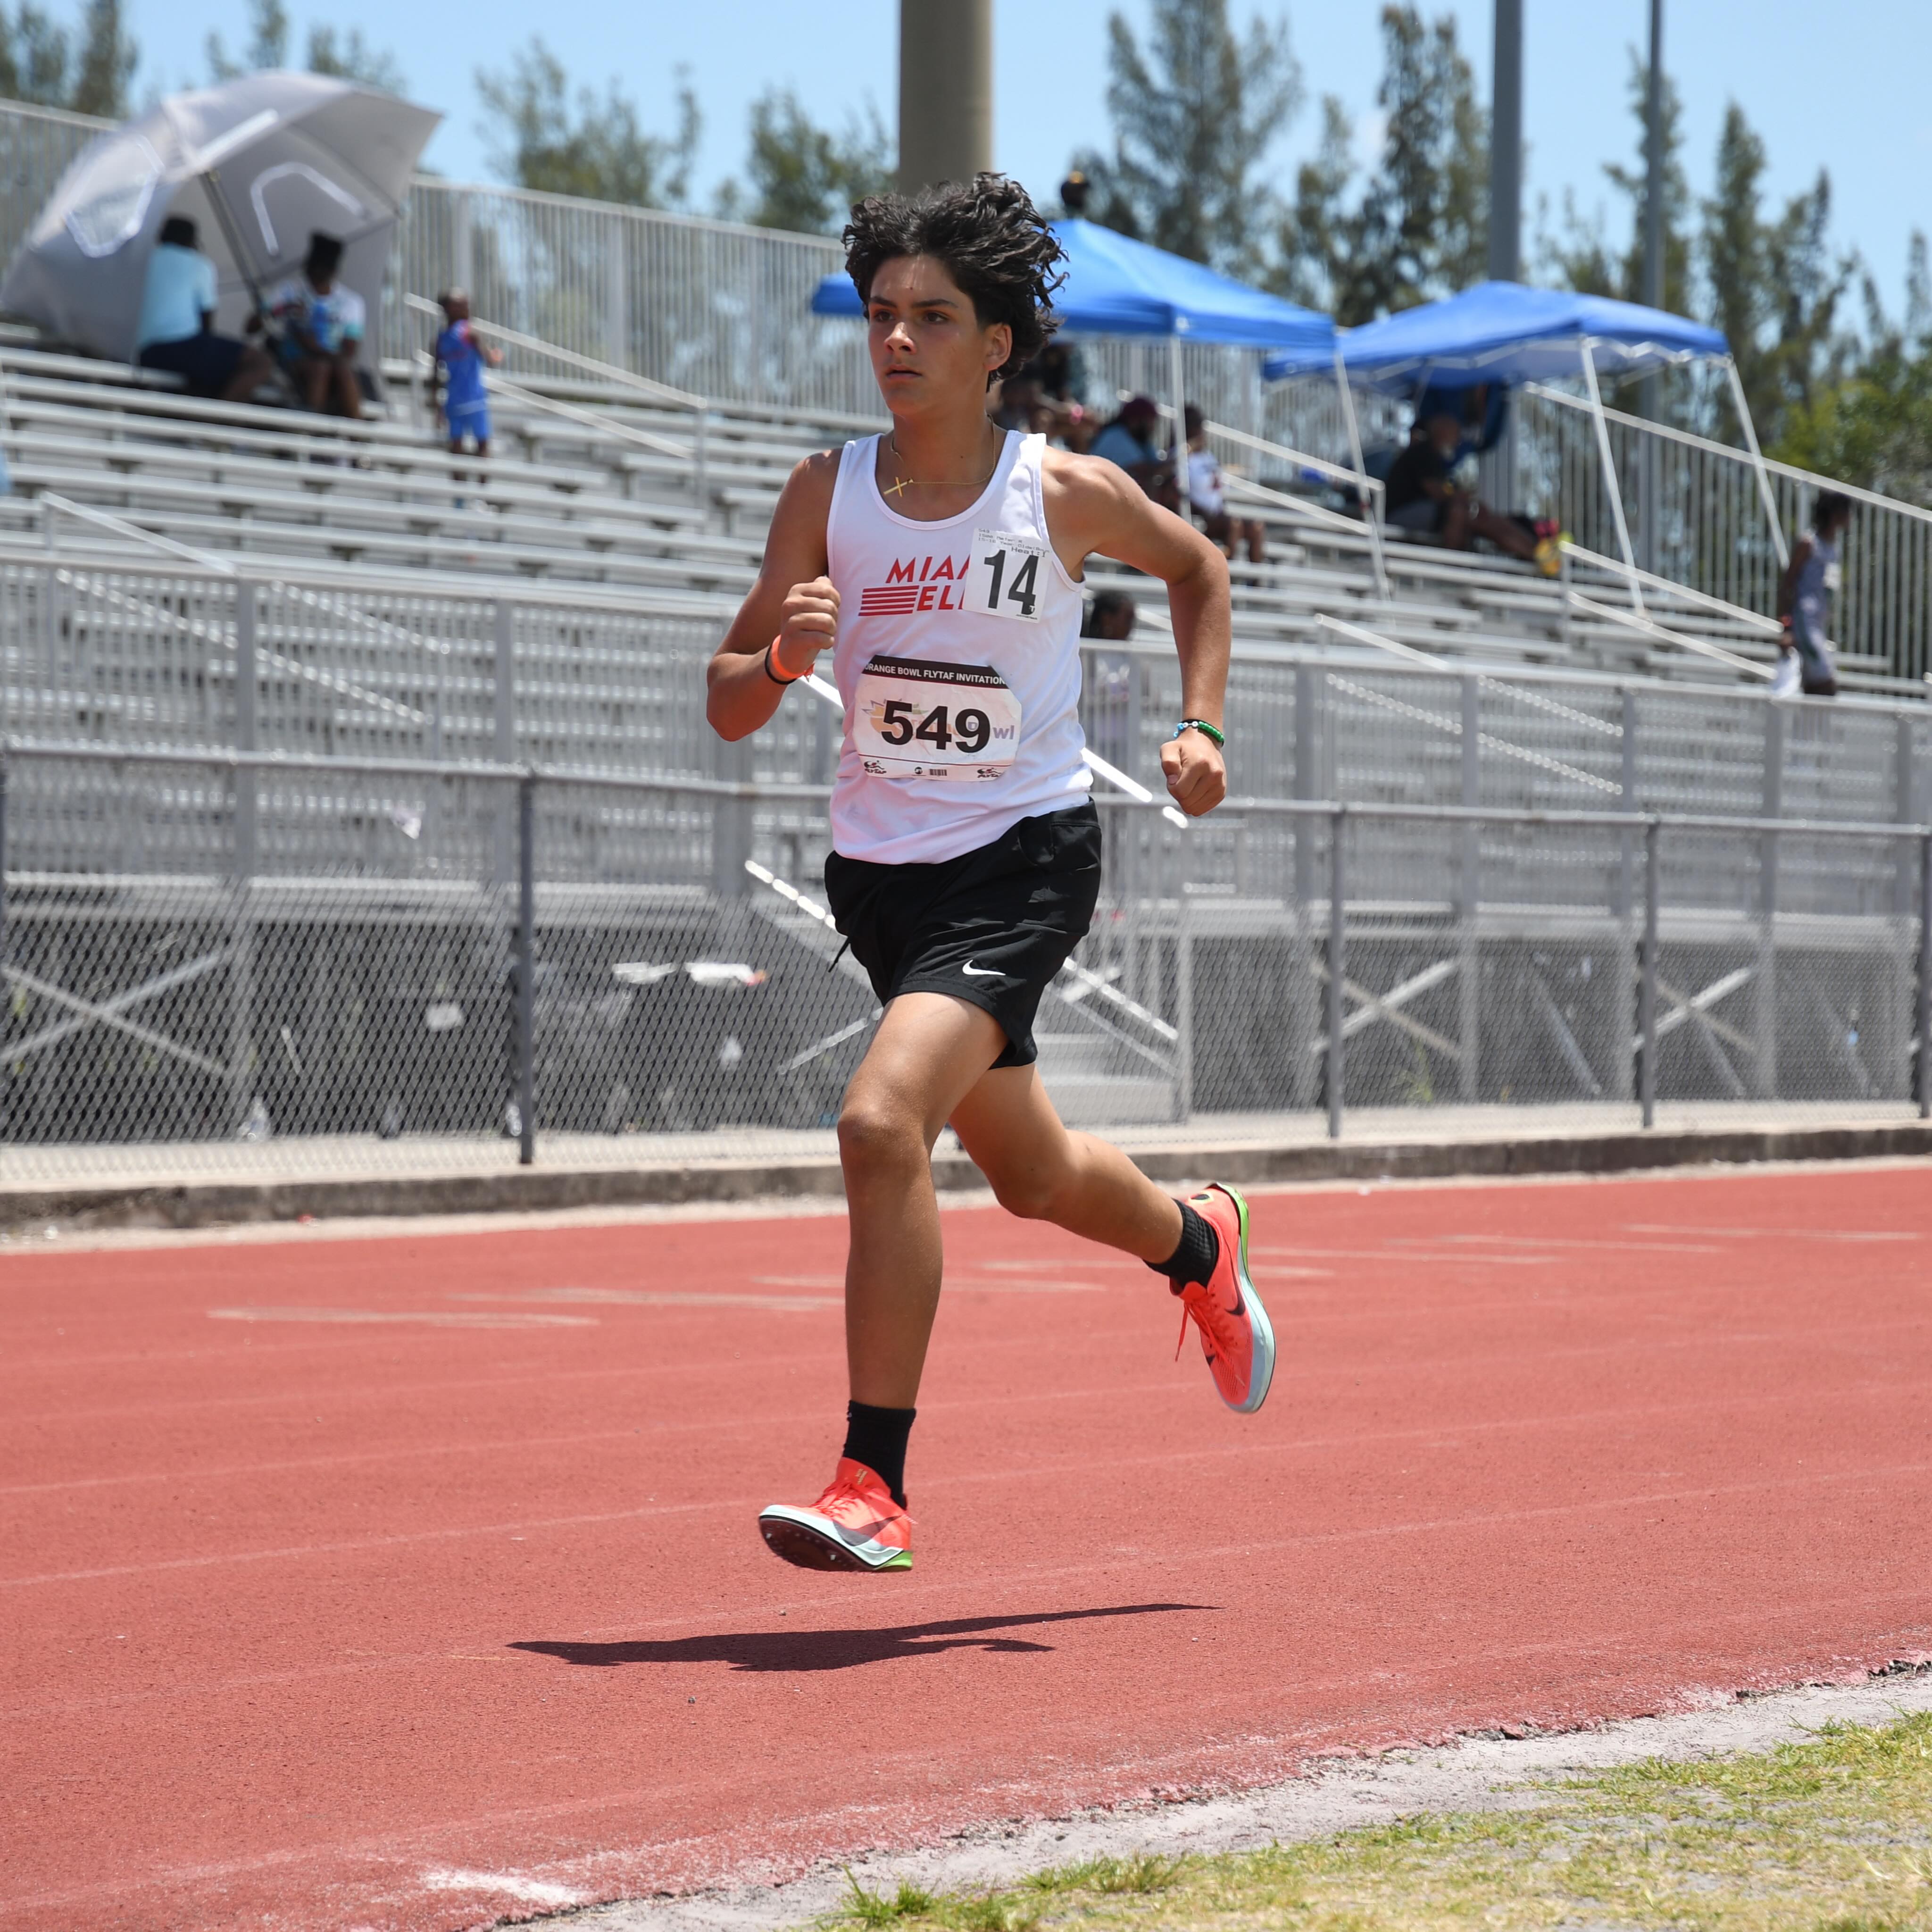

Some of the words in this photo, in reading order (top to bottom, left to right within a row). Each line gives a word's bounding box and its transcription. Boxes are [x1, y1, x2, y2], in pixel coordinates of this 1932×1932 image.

[984, 549, 1039, 615] 14
[898, 667, 922, 677] BOWL
[923, 669, 955, 680] FLYTAF
[881, 700, 991, 753] 549
